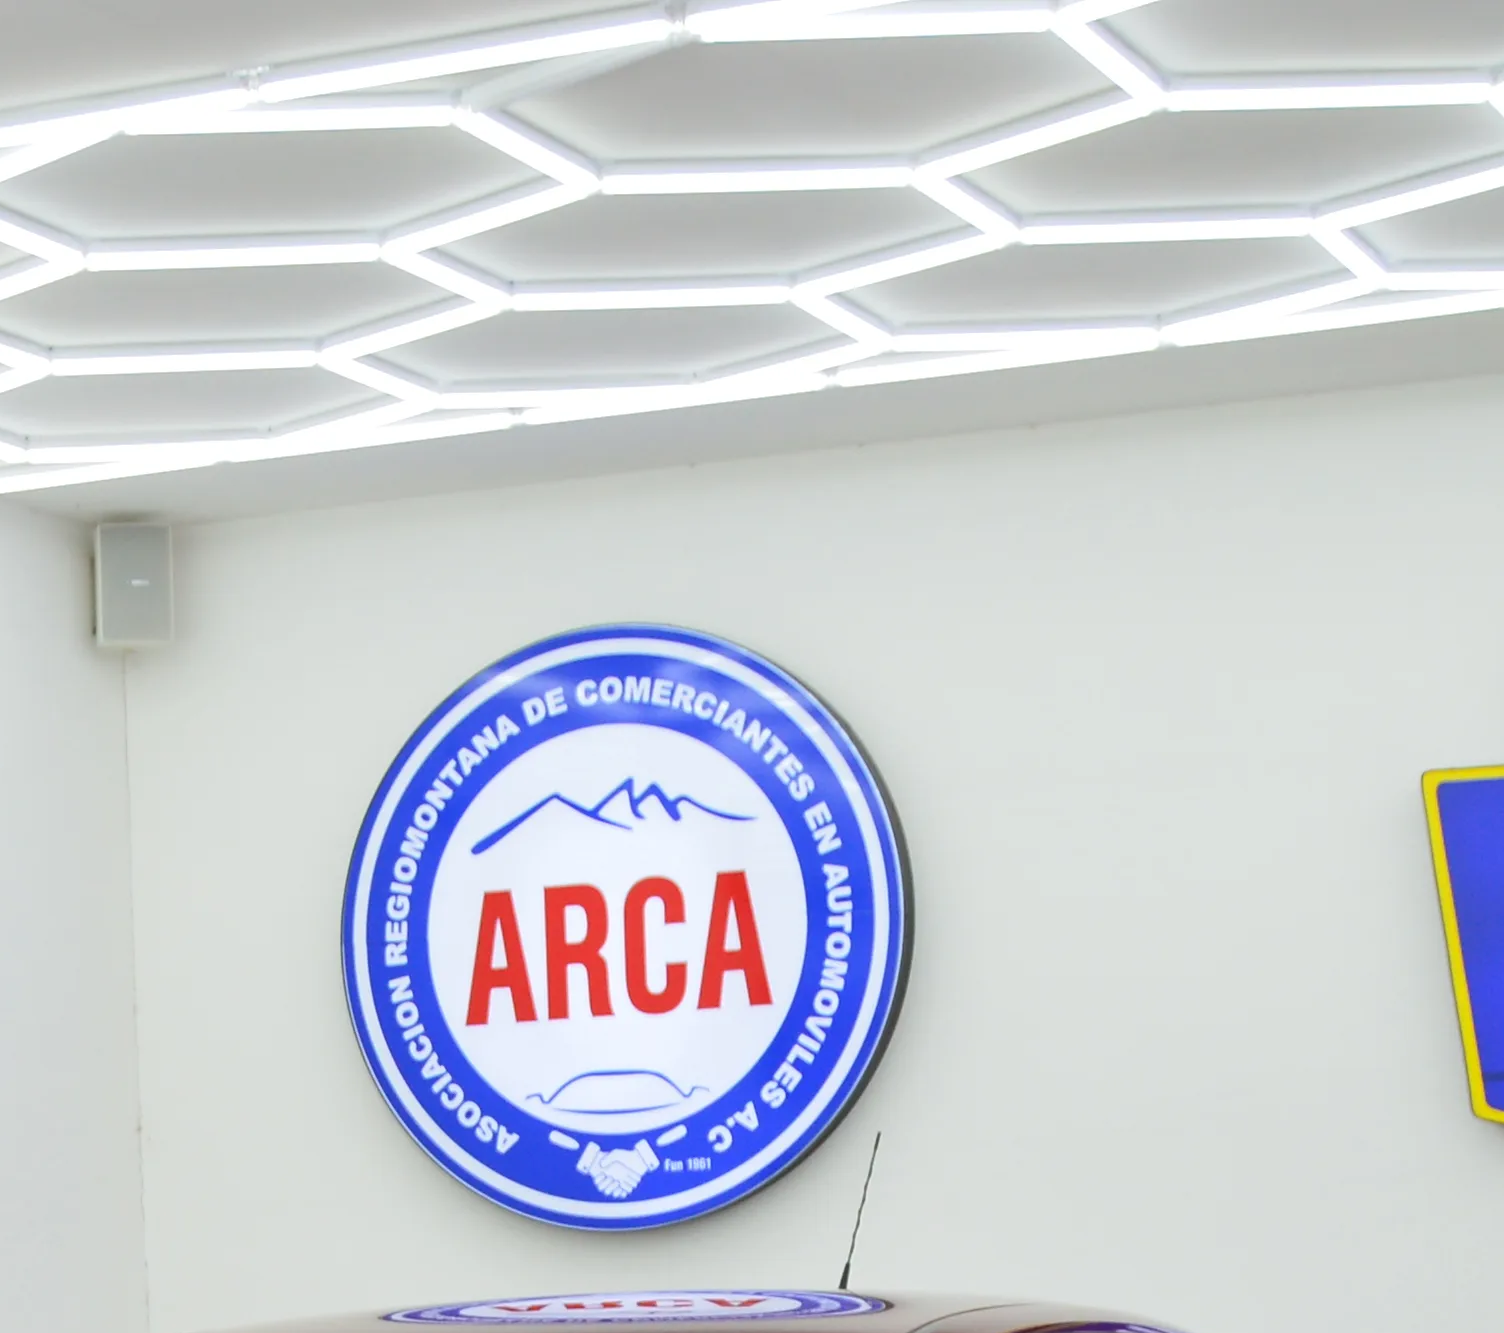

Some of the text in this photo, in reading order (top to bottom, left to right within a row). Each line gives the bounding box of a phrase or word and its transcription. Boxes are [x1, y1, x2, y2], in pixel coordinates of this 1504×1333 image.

[522, 685, 568, 726] DE
[574, 675, 815, 801] COMERCIANTES
[384, 714, 521, 966] REGIOMONTANA
[804, 800, 842, 855] EN
[465, 870, 773, 1027] ARCA
[760, 863, 853, 1108] AUTOMOVILES
[388, 975, 520, 1154] ASOCIACION
